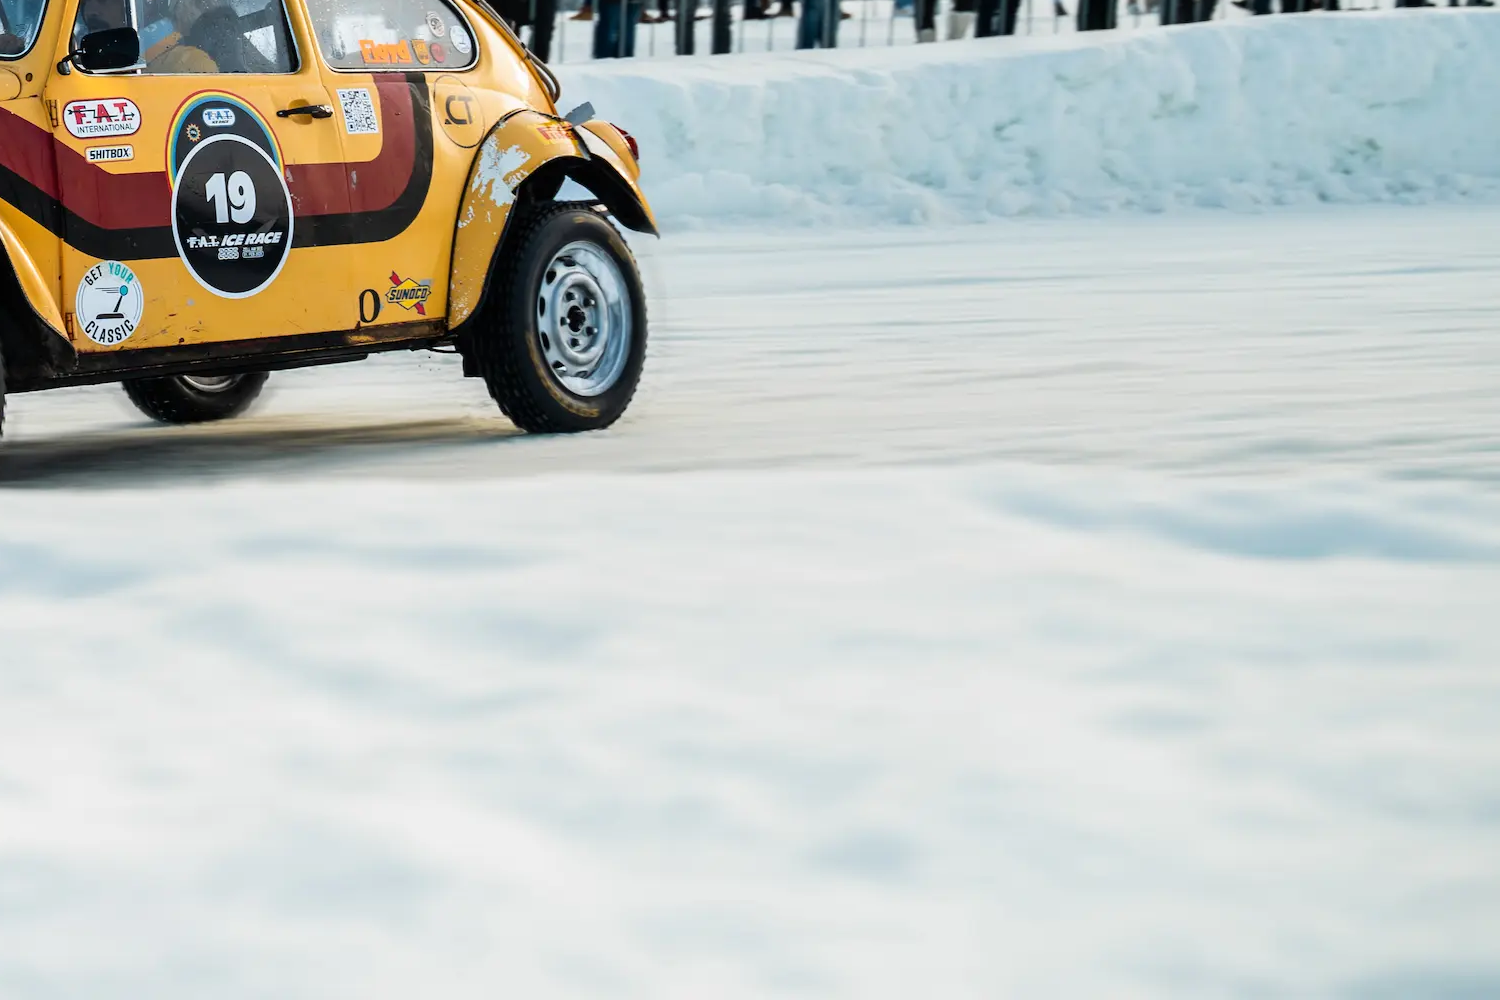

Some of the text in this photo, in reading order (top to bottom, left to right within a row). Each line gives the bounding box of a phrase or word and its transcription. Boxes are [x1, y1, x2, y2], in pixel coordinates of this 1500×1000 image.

[358, 40, 413, 64] Floyd
[73, 102, 133, 125] F.A.T.
[76, 123, 134, 134] INTERNATIONAL
[89, 148, 130, 160] SHITBOX
[205, 170, 256, 224] 19
[221, 234, 245, 247] ICE
[245, 232, 283, 246] RACE
[85, 262, 134, 286] GET YOUR
[389, 287, 428, 301] SUNOCO
[85, 319, 134, 343] CLASSIC
